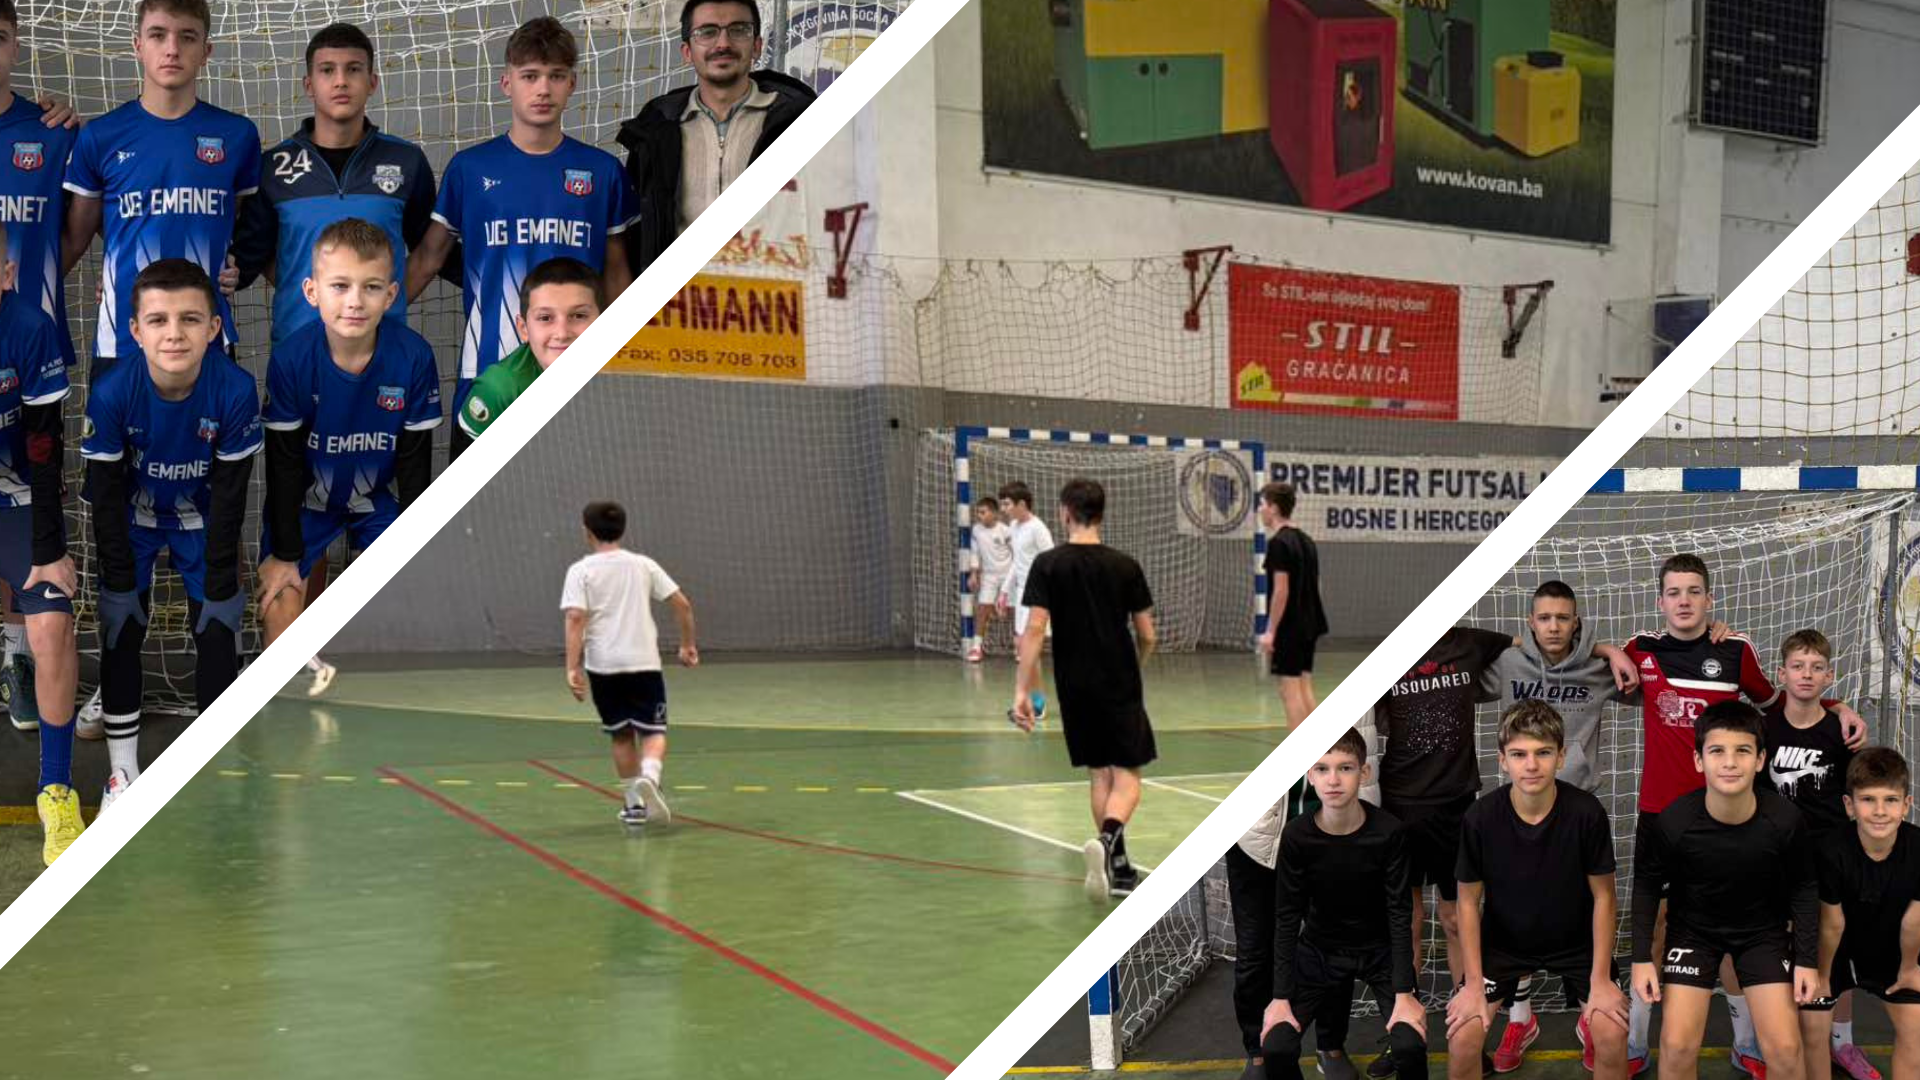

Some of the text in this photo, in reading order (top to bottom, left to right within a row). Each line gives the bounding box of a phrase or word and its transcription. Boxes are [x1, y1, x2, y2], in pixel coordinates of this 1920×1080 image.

[272, 149, 312, 176] 24
[1417, 166, 1543, 198] www.kovan.ba
[118, 187, 228, 218] UG EMANET
[484, 218, 592, 248] UG EMANET
[616, 346, 661, 361] Fax:
[716, 351, 753, 367] 708
[760, 353, 798, 369] 703
[308, 431, 398, 454] G EMANET
[147, 459, 210, 481] EMANE
[1271, 462, 1420, 498] PREMIJER
[1428, 468, 1532, 501] FUTSAL
[1327, 507, 1511, 532] BOSNE I HERCEGO
[1391, 671, 1471, 697] DSQUARED
[1511, 680, 1590, 703] Whops
[1773, 745, 1823, 769] NIKE
